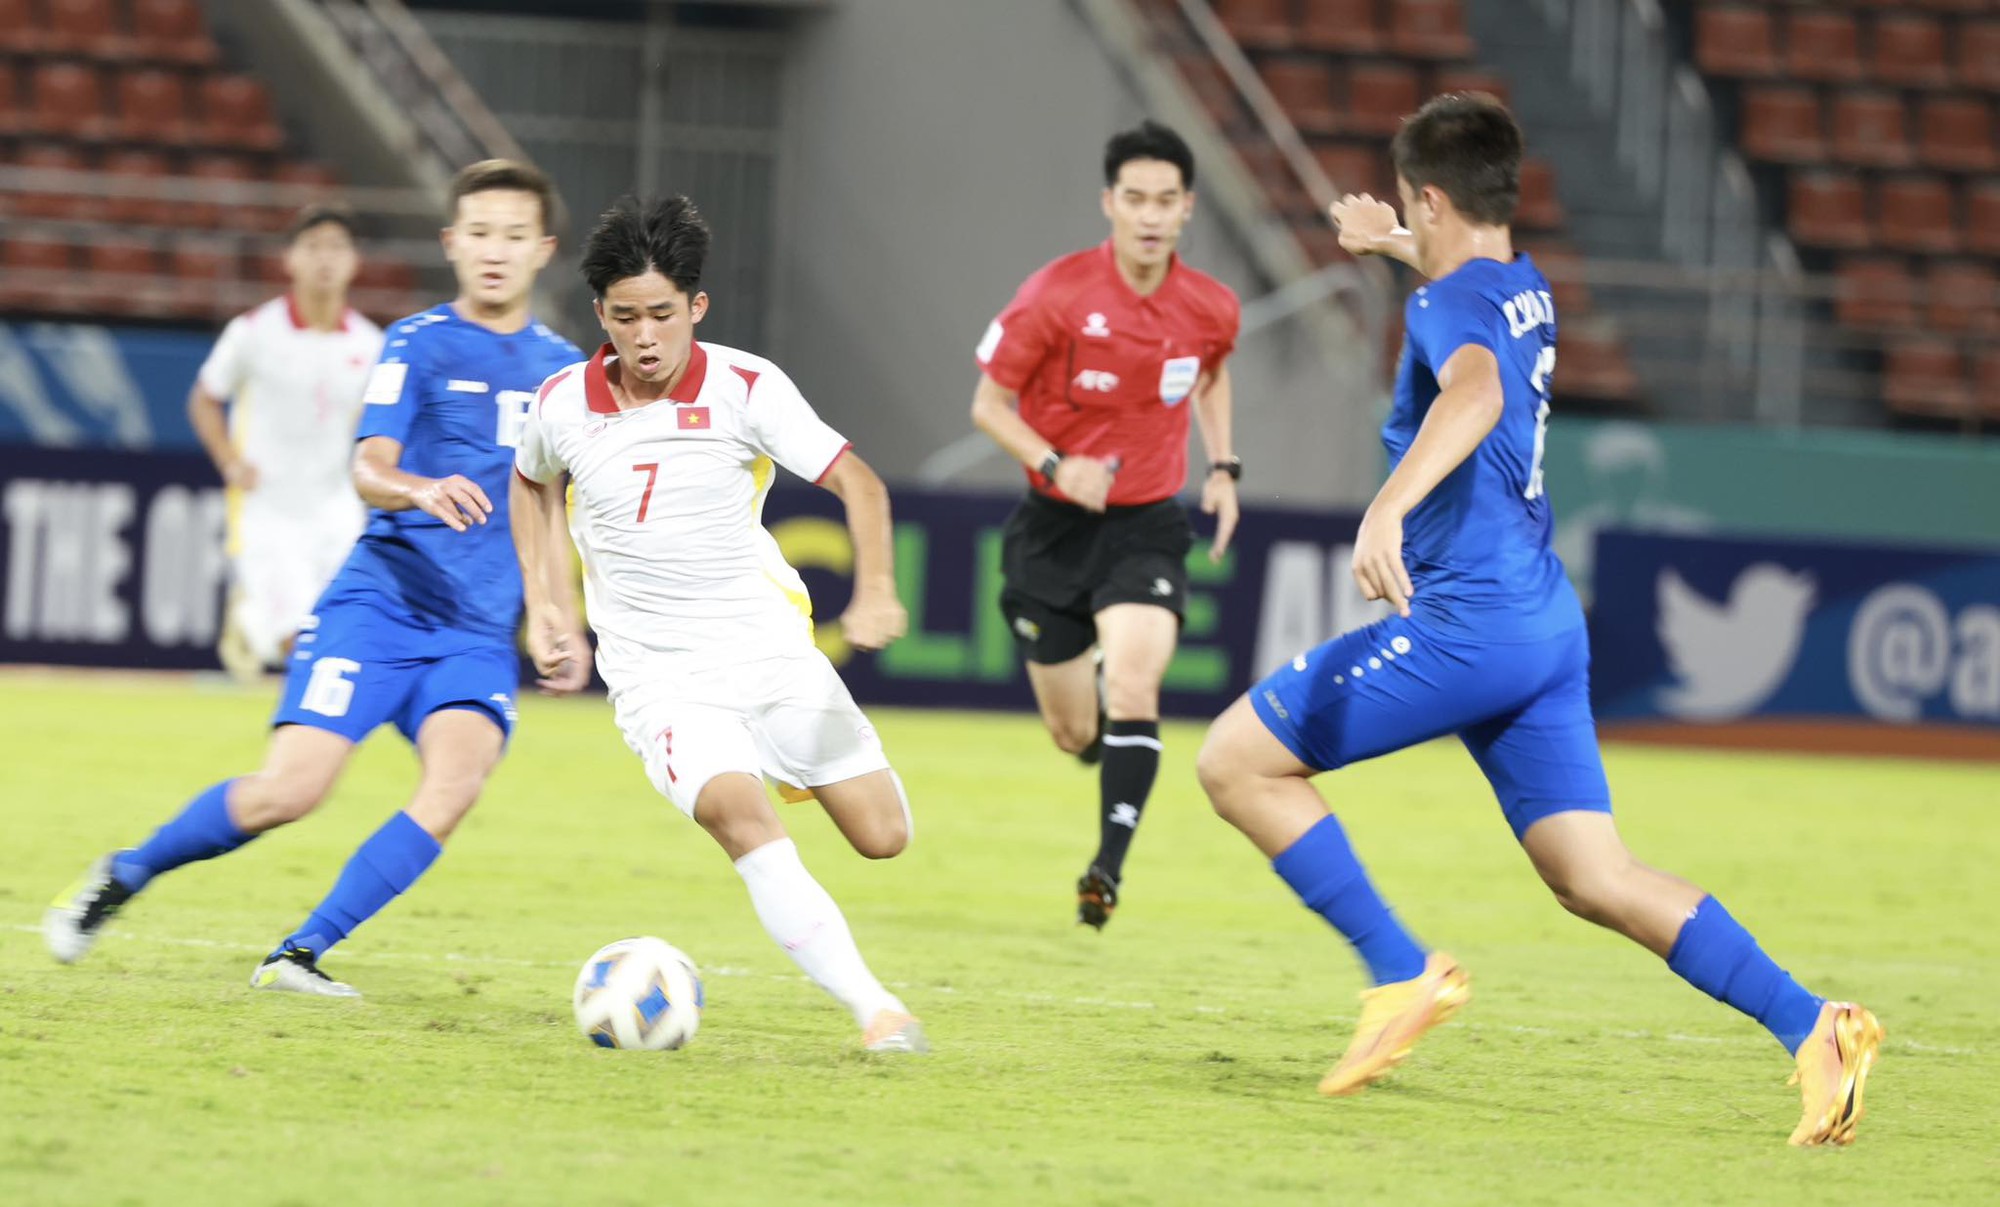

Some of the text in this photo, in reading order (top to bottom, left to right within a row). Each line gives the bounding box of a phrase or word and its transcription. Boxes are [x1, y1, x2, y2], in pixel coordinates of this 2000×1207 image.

[632, 462, 658, 523] 7
[5, 480, 135, 642] THE
[299, 657, 361, 717] 16
